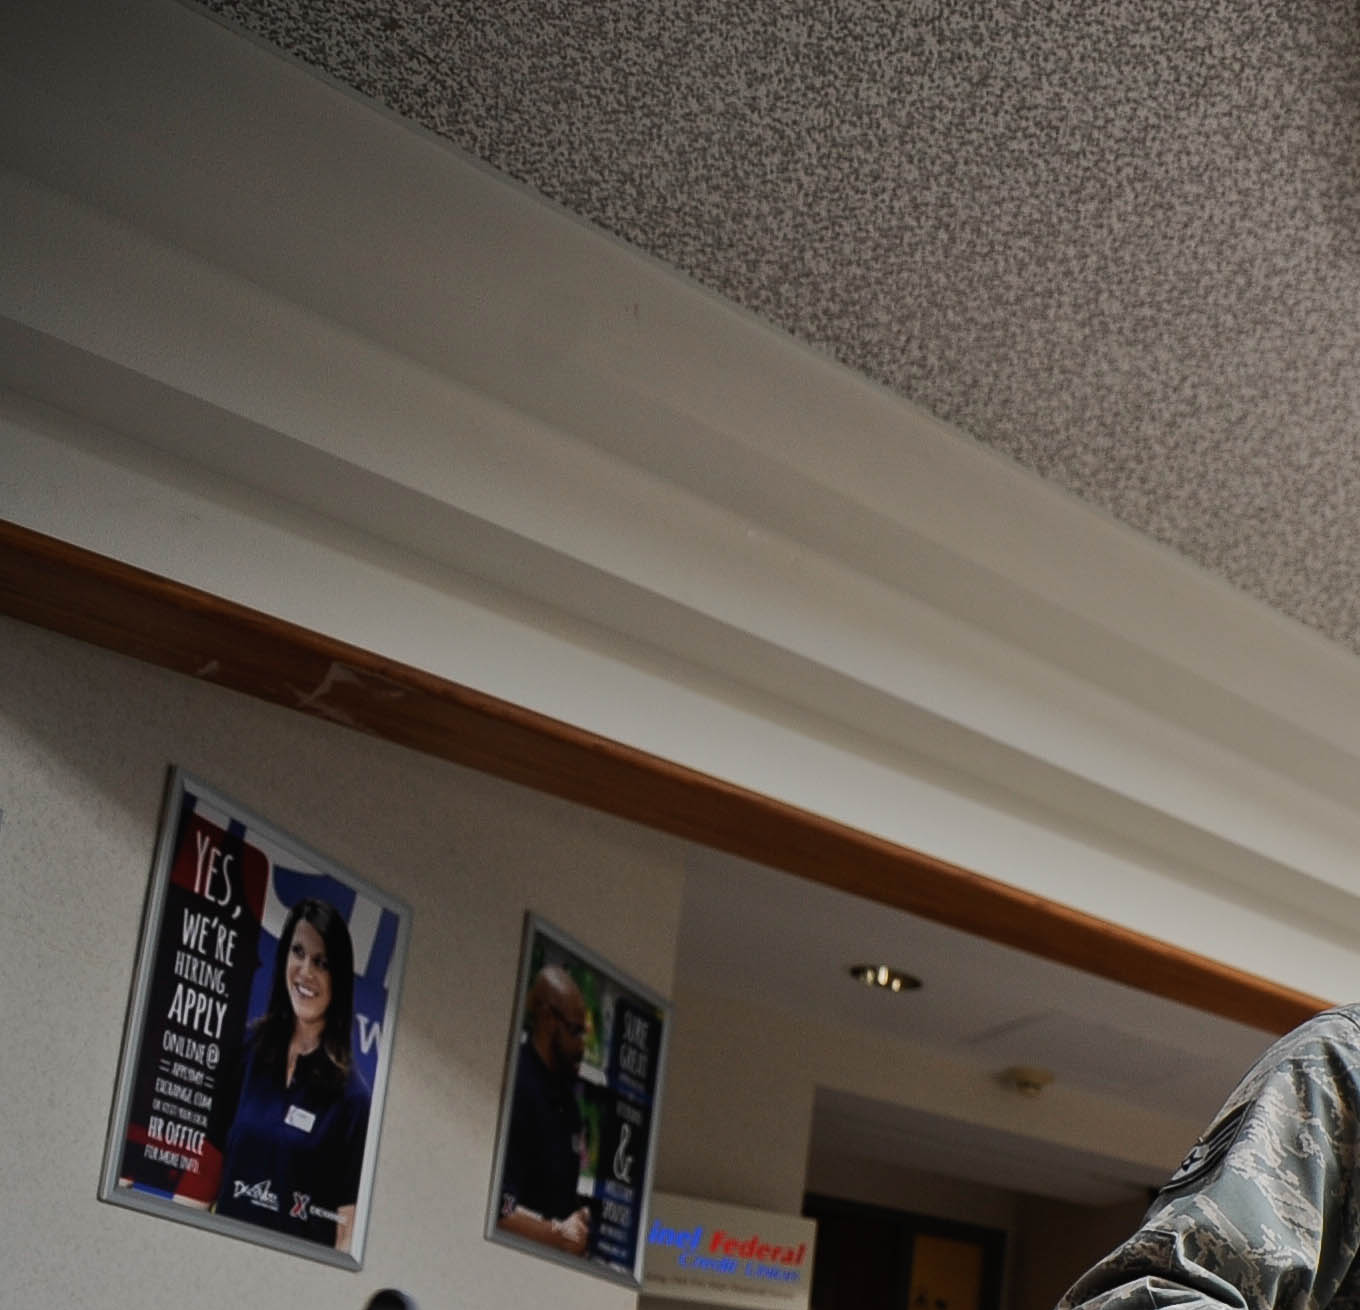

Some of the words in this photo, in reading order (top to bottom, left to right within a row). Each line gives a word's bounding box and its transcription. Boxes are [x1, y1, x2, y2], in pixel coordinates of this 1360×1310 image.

[194, 829, 242, 919] YES,
[182, 908, 238, 967] WE'RE
[174, 950, 229, 998] HIRING.
[167, 983, 228, 1040] APPLY
[148, 1115, 164, 1142] HR
[165, 1121, 206, 1156] OFFICE
[709, 1228, 806, 1268] Federal
